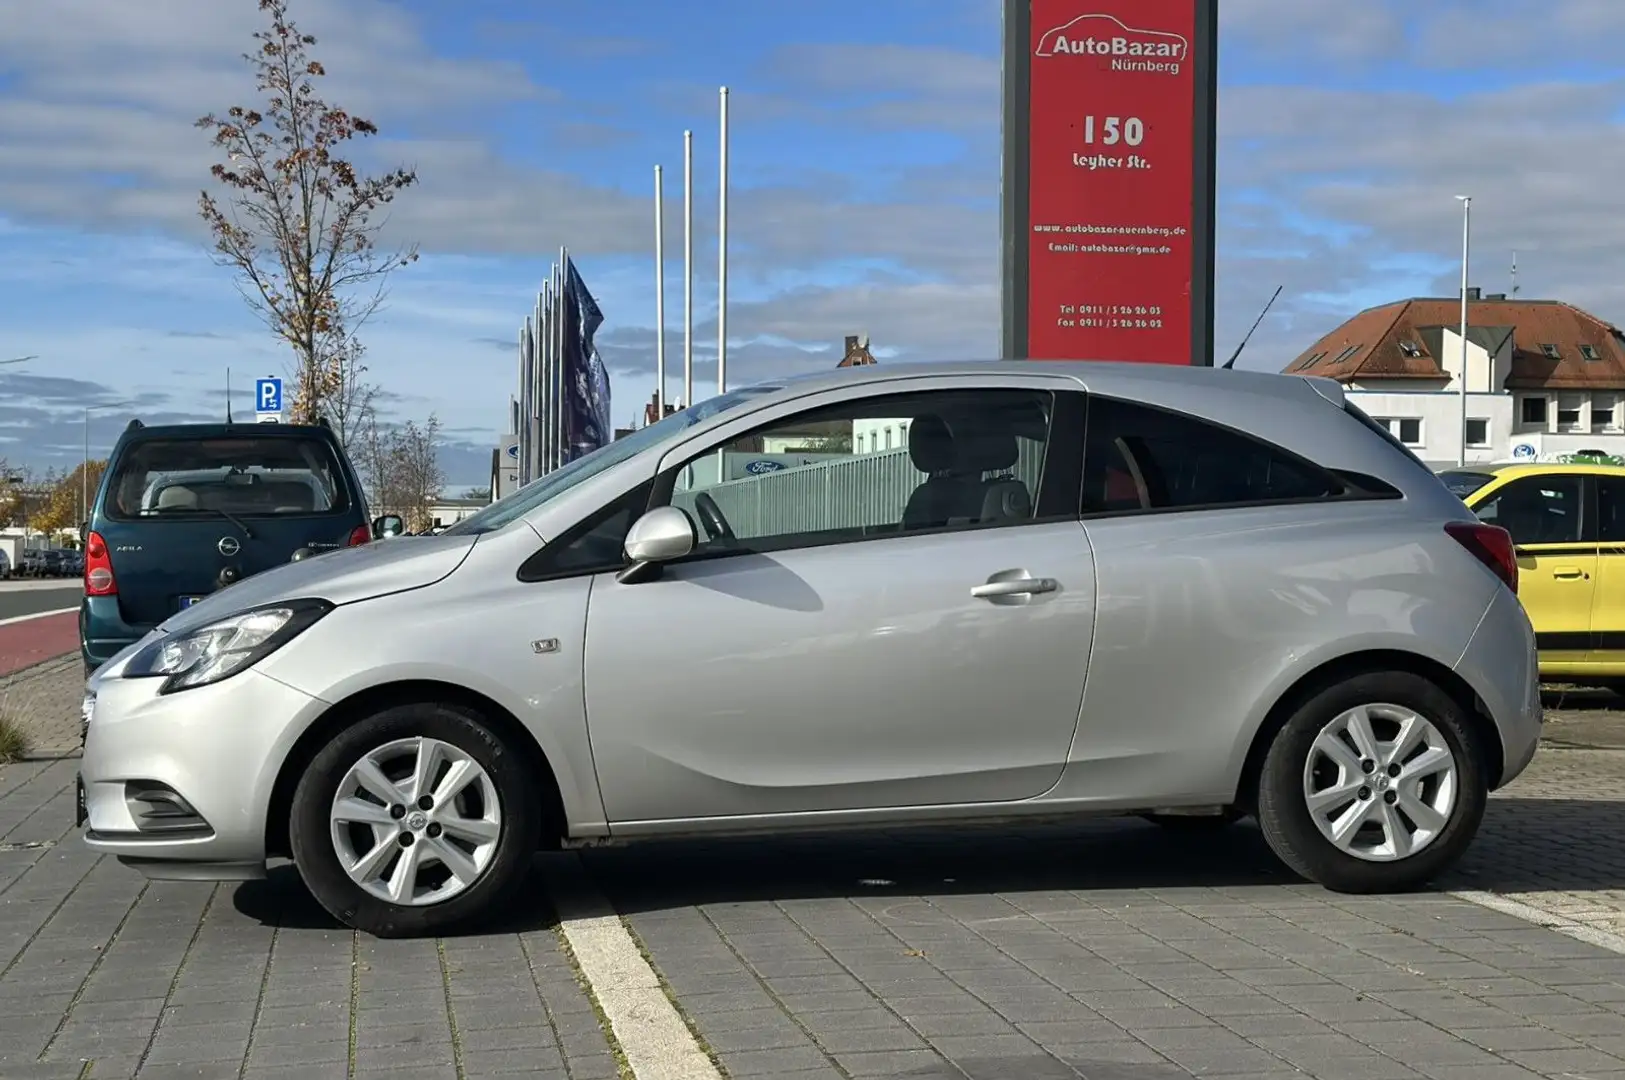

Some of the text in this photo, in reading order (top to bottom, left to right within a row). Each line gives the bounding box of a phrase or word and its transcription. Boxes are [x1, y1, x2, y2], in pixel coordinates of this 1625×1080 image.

[1053, 35, 1182, 57] AutoBazar
[1111, 59, 1180, 75] Nürnberg
[1084, 115, 1144, 146] 150
[1072, 153, 1152, 170] Leyher Str.
[1048, 242, 1172, 255] Email: autobazar@gmx.de
[1060, 305, 1075, 314] Tel
[1057, 318, 1075, 327] Fax
[261, 382, 277, 409] P
